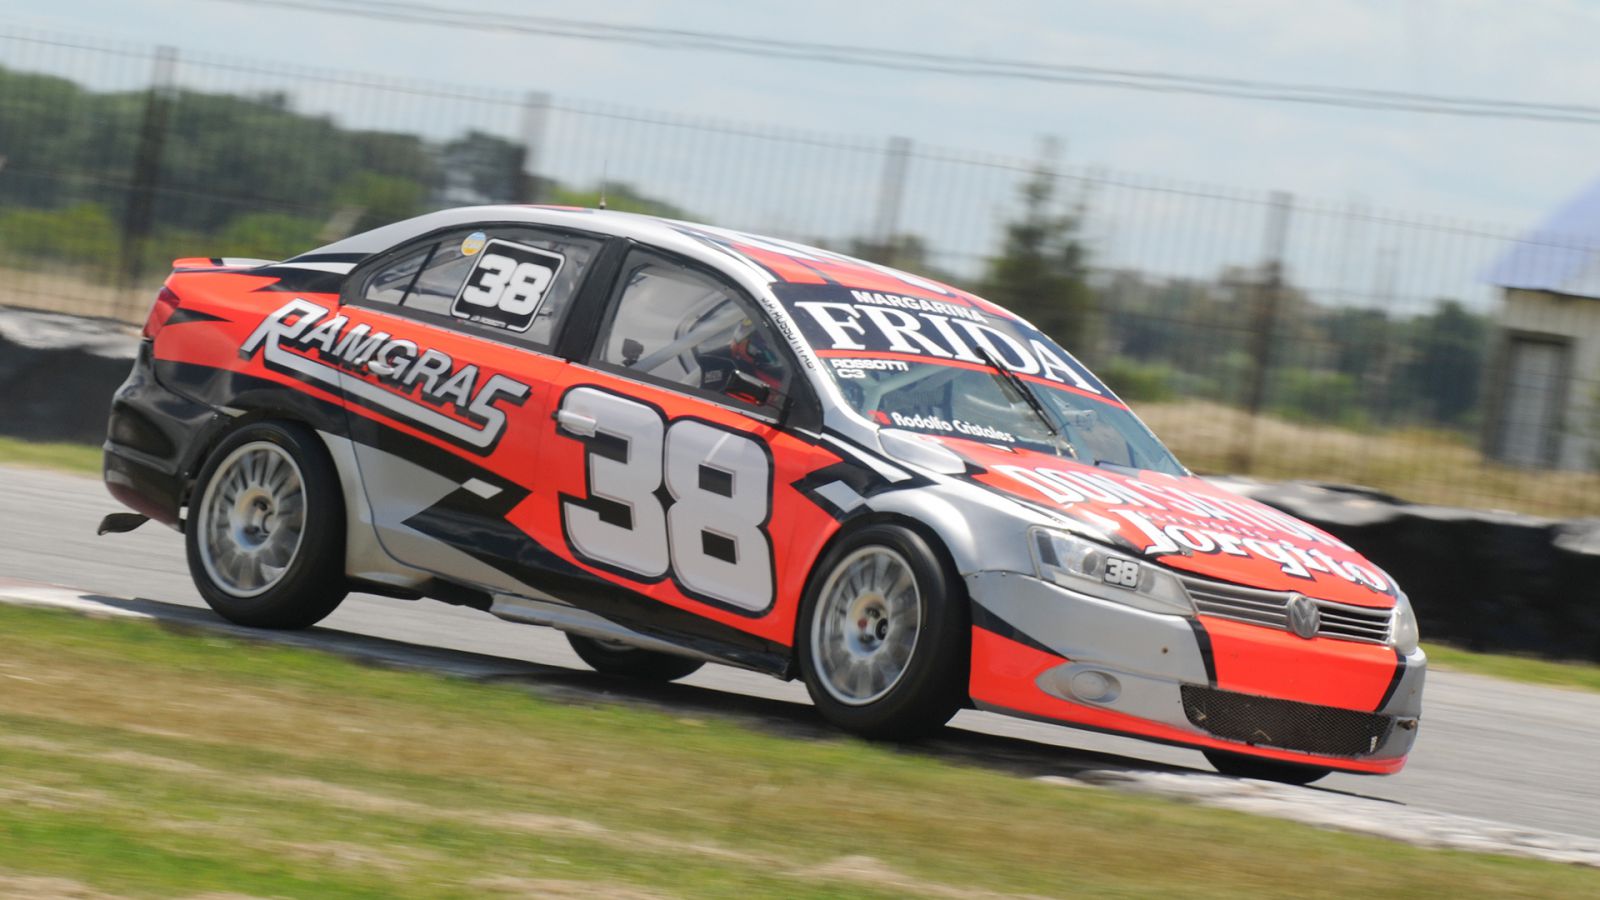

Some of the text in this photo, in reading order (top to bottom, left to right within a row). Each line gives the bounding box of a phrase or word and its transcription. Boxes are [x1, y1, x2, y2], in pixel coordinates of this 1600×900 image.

[463, 254, 553, 316] 38
[851, 289, 989, 323] MARGARINA
[794, 301, 1102, 395] FRIDA
[829, 358, 909, 372] ROSSOTTI
[239, 297, 532, 453] RAMGRAS
[836, 368, 866, 379] C3
[891, 411, 1016, 443] Rodolfo Cristales
[557, 385, 776, 615] 38
[989, 464, 1169, 511] DON
[1104, 557, 1138, 587] 38
[1108, 509, 1389, 592] Jorgito
